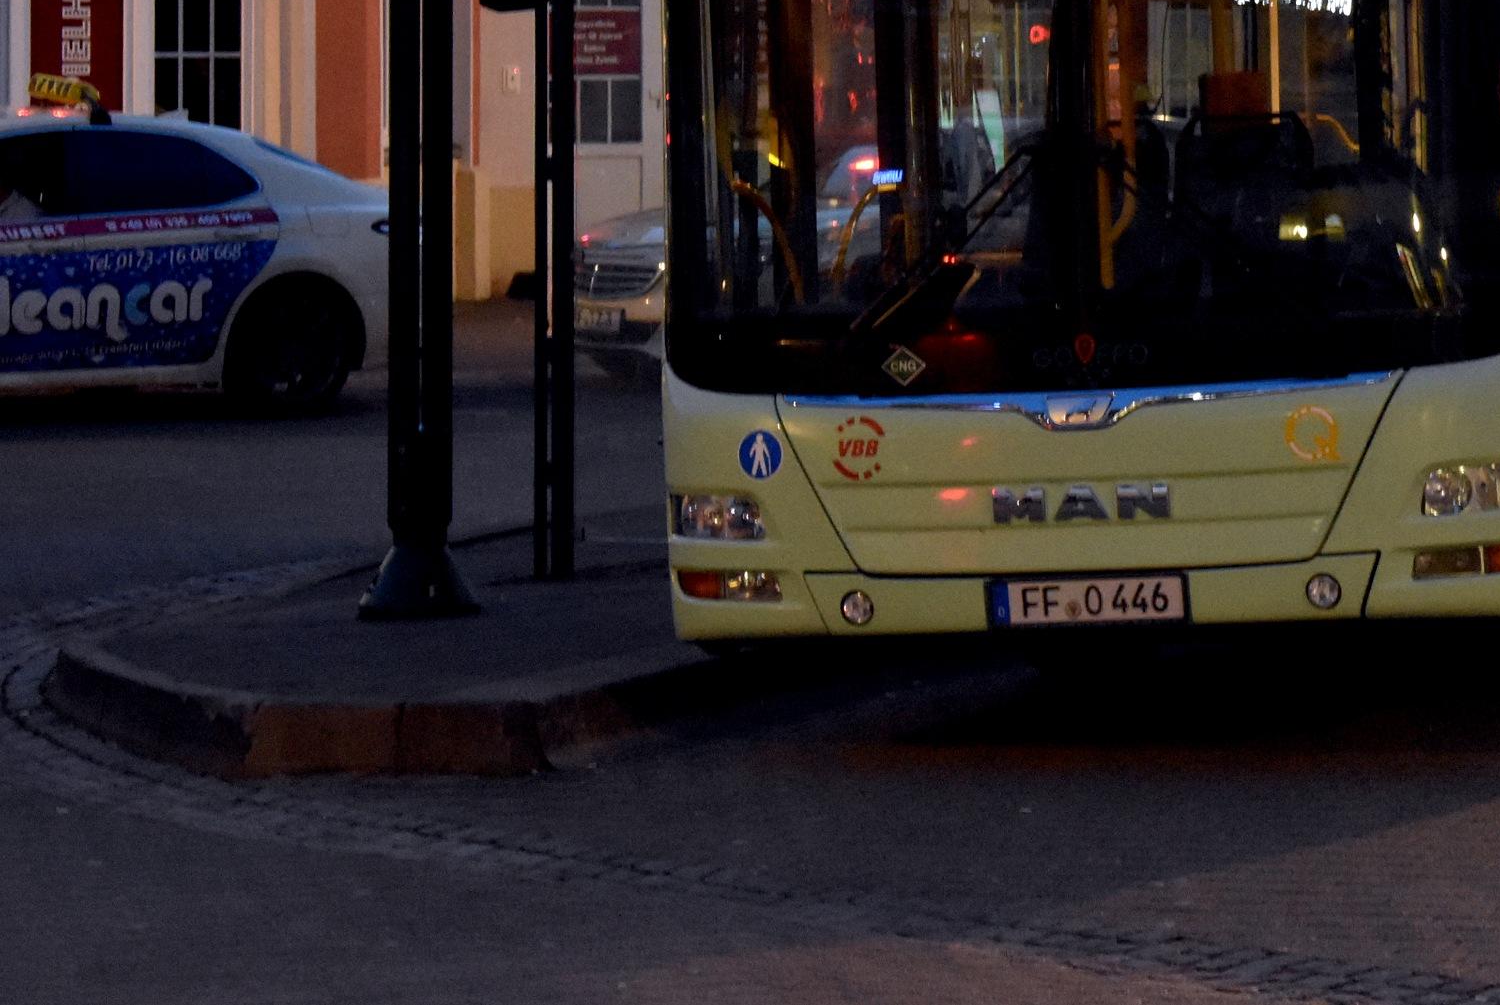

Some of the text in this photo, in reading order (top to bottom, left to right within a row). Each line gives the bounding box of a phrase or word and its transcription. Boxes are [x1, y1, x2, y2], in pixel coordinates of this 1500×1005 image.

[889, 360, 918, 373] CNG
[838, 438, 879, 460] VBB
[991, 483, 1172, 524] MAN
[1021, 585, 1060, 618] FF
